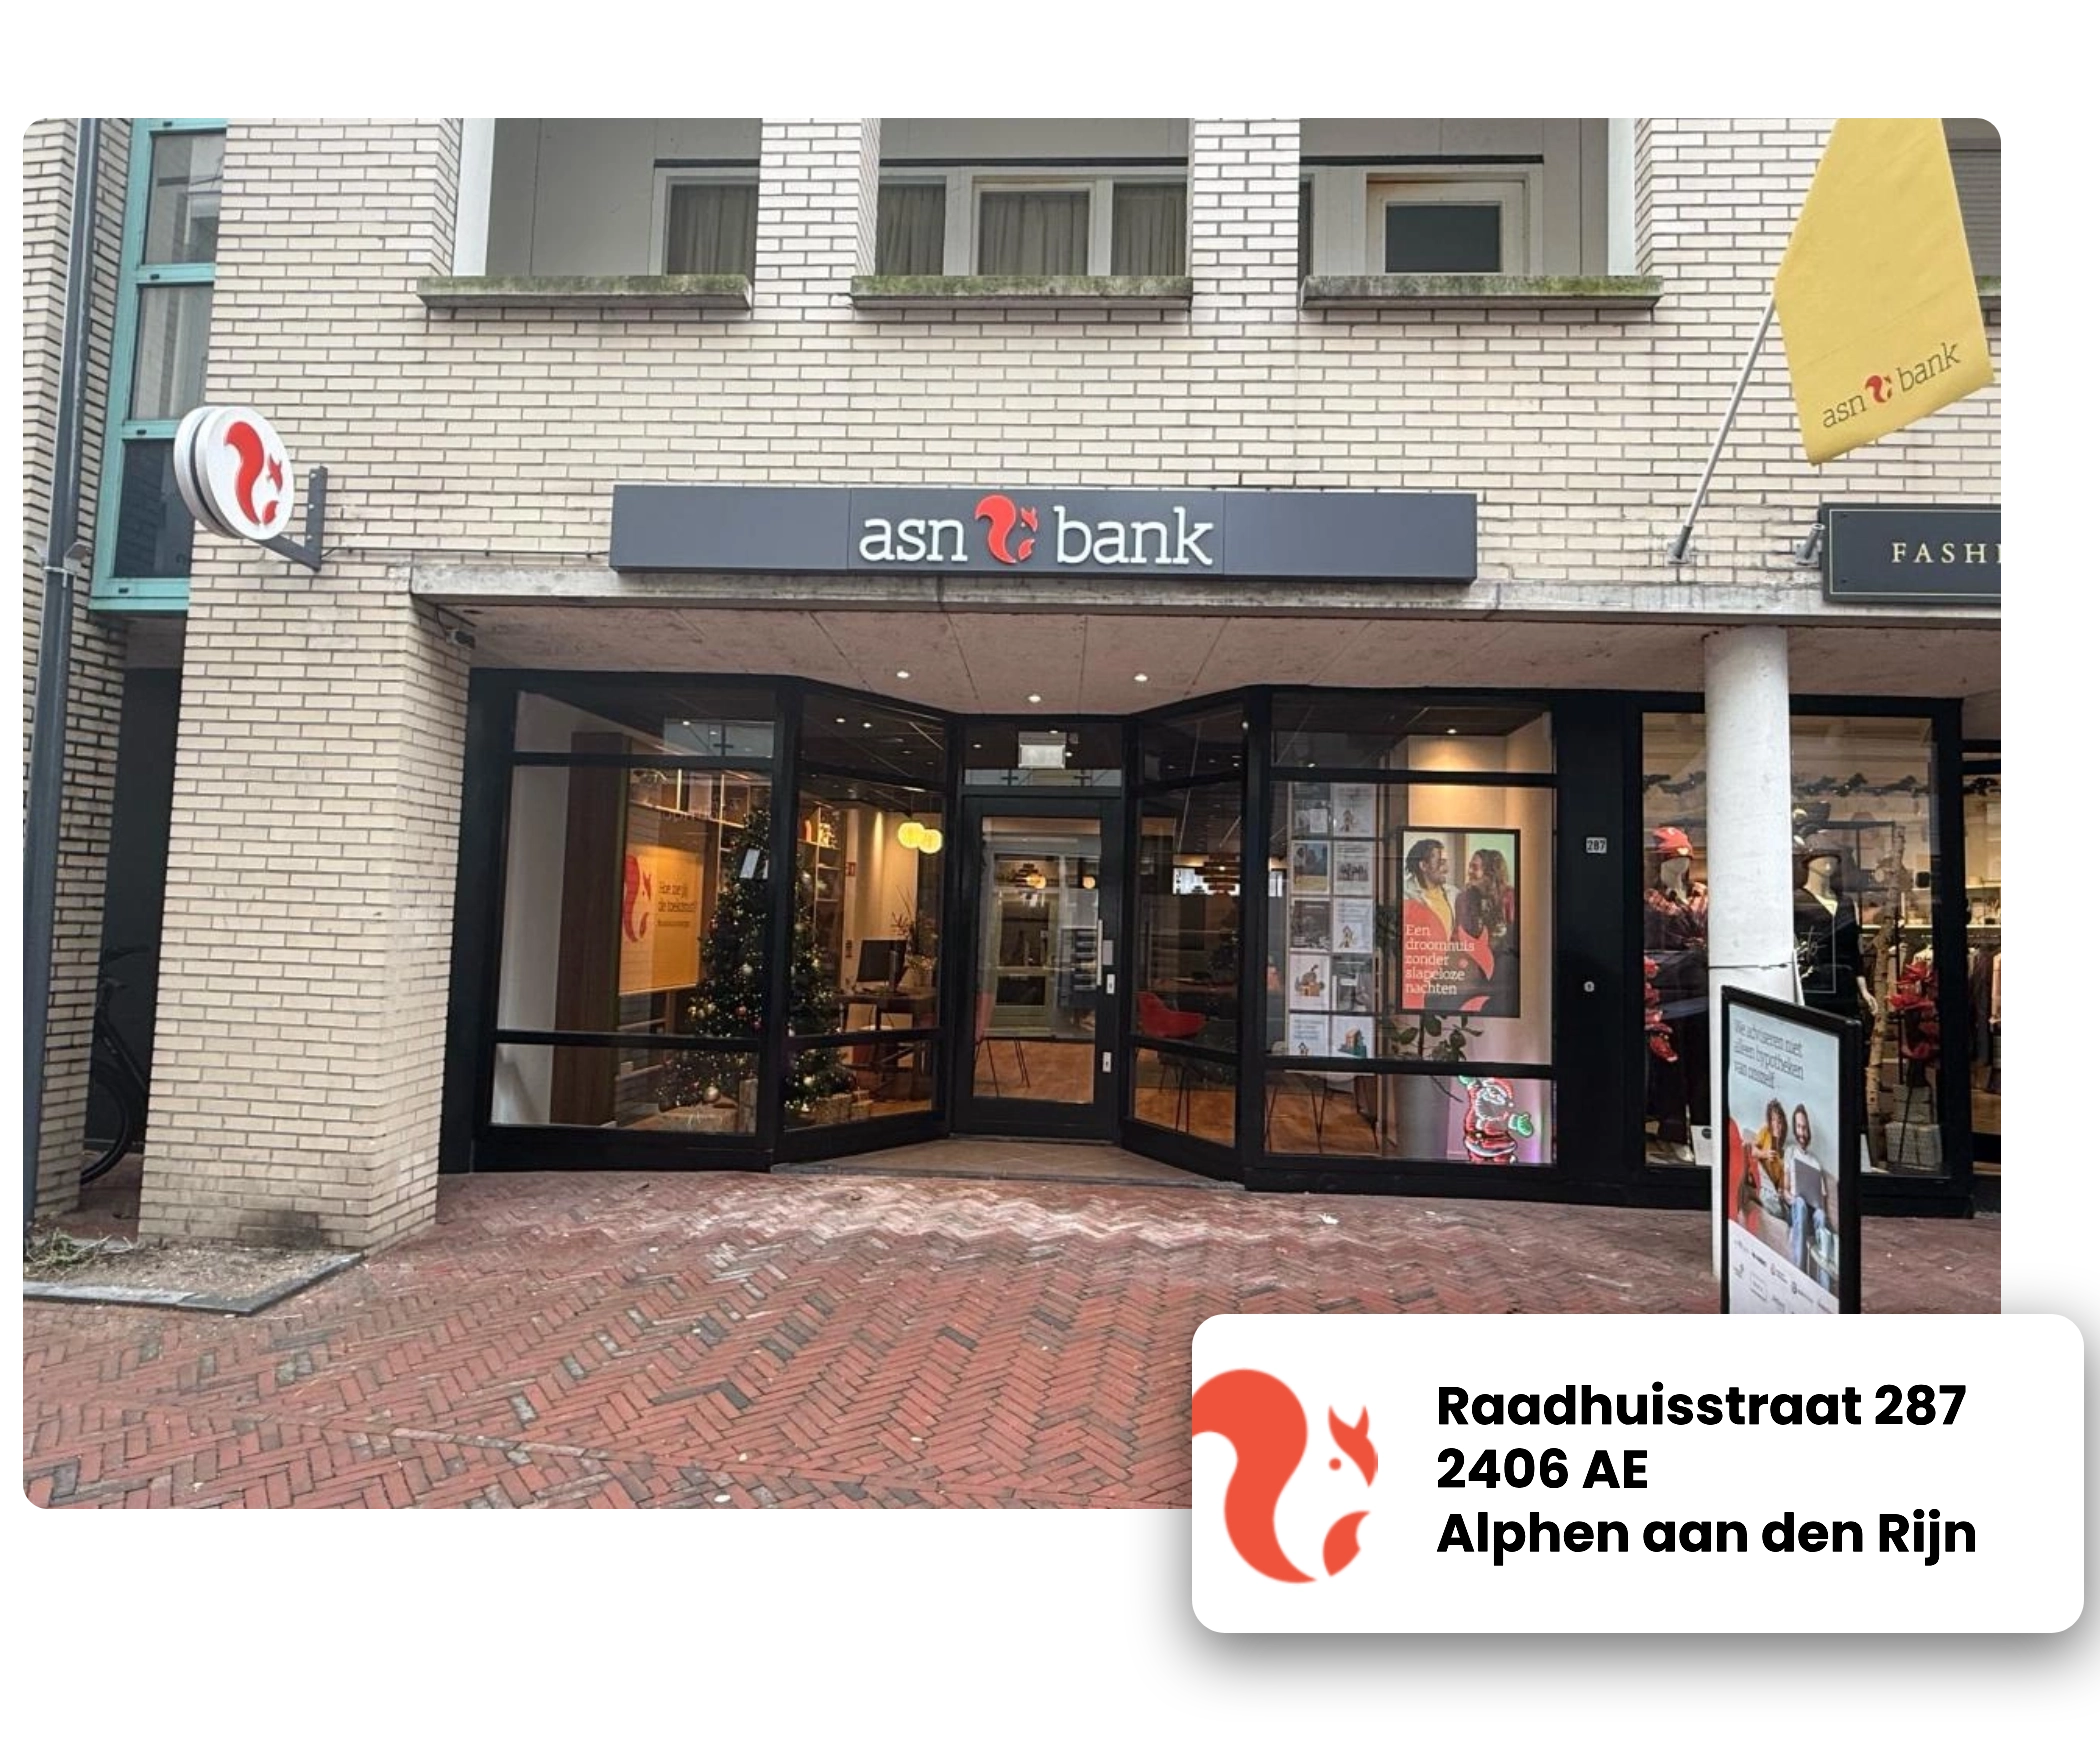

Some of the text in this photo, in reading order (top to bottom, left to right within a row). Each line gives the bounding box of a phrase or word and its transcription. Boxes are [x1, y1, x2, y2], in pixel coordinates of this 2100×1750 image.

[1822, 342, 1961, 428] asn bank
[859, 505, 1214, 566] asn bank
[1587, 839, 1606, 851] 287
[1406, 924, 1431, 936] Een
[1405, 938, 1476, 952] droomhuis
[1405, 952, 1440, 966] zonder
[1405, 966, 1467, 981] slapeloze
[1405, 980, 1458, 995] nachten
